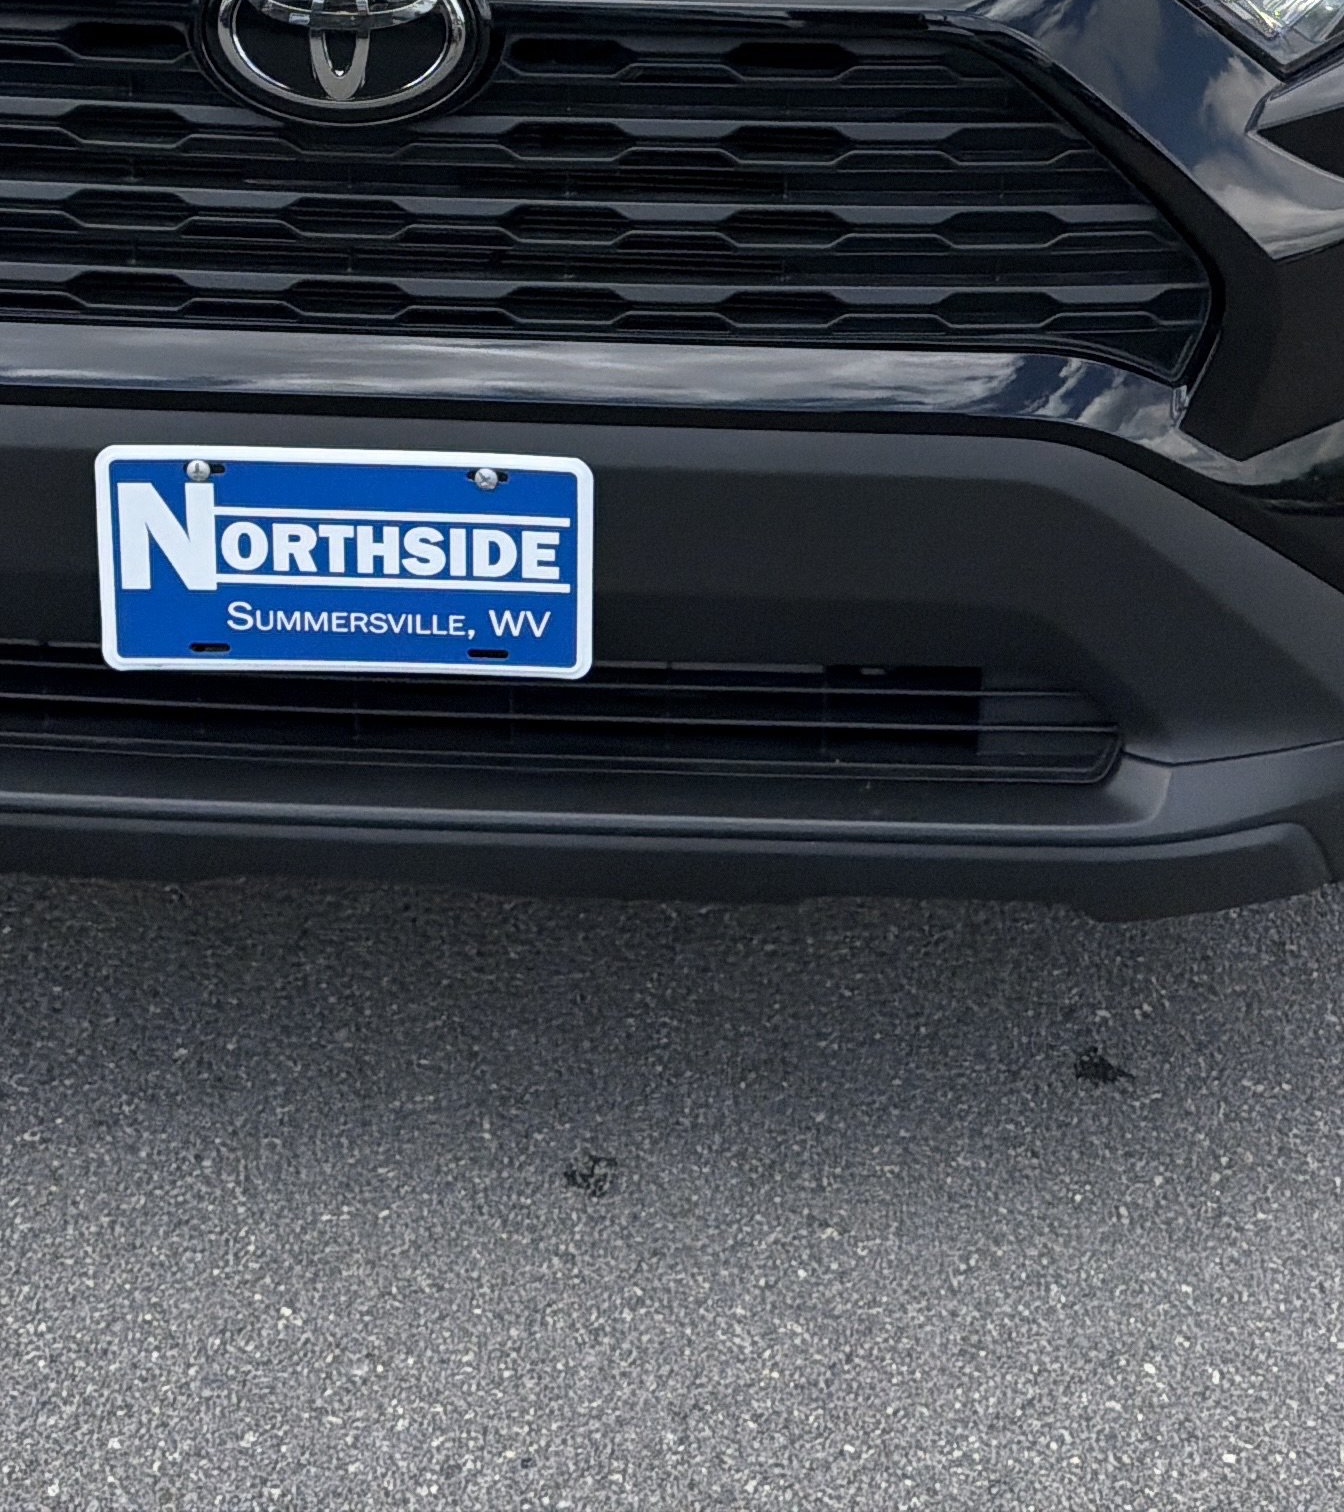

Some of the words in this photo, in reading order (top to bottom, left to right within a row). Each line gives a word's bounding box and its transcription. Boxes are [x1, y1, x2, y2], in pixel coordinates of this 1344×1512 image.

[117, 481, 561, 591] NORTHSIDE
[227, 600, 476, 640] SUMMERSVILLE,
[488, 608, 552, 638] WV
